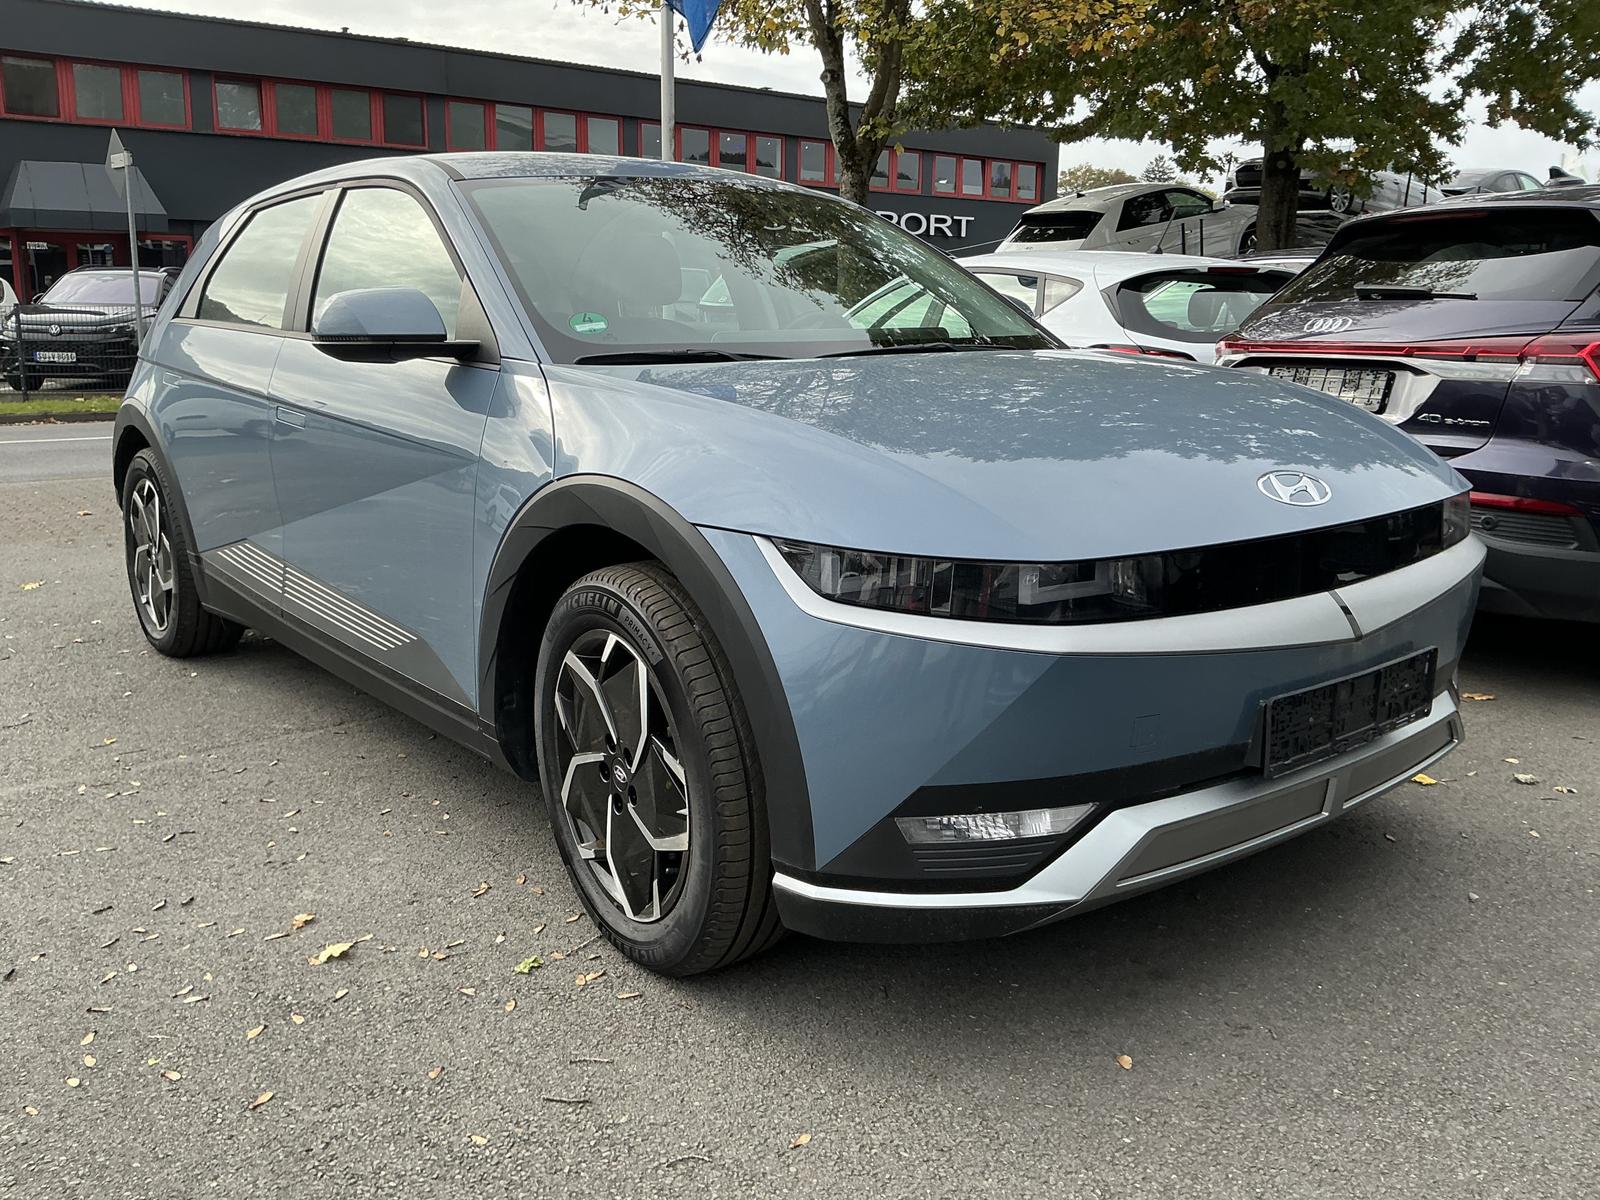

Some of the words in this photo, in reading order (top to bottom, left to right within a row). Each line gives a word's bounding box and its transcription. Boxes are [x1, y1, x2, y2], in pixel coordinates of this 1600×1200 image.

[1417, 413, 1442, 424] 40
[559, 592, 619, 616] MICHELIN
[624, 616, 653, 651] PRIMACY
